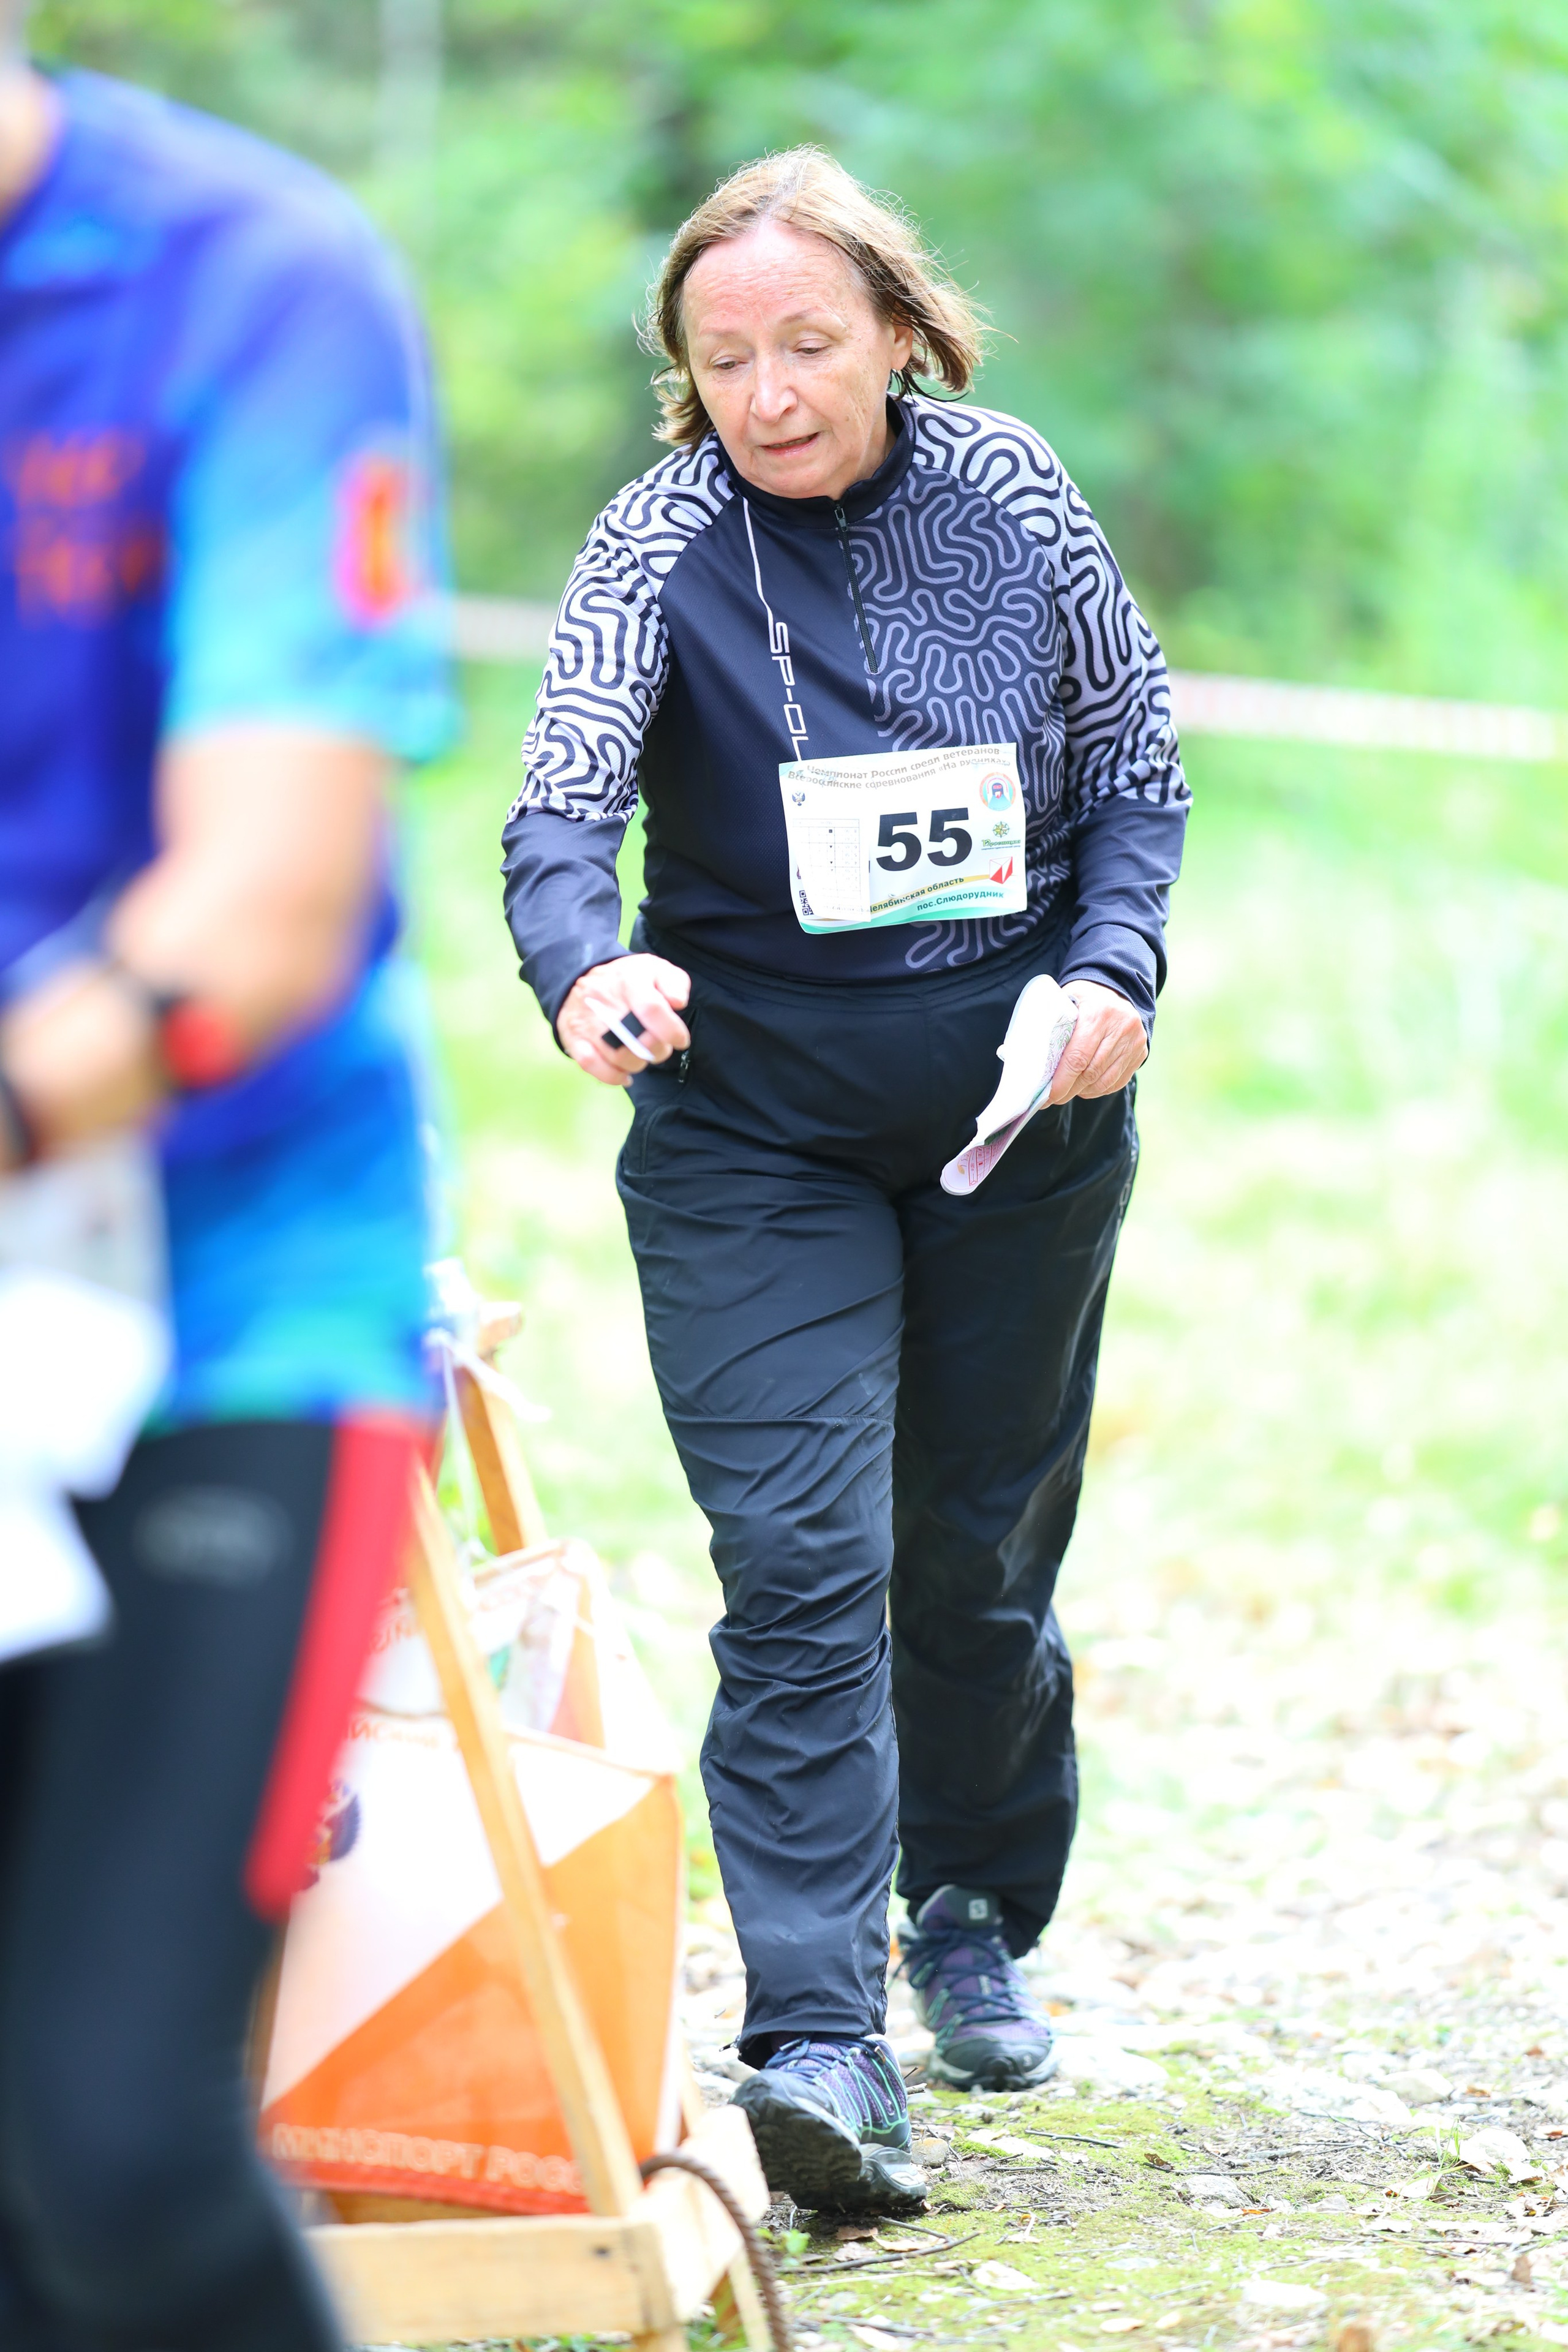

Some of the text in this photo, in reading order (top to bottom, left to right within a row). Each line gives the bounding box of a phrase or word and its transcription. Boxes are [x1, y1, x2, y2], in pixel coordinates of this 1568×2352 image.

[807, 748, 1000, 779] Чемпионат России среди ветеранов
[865, 768, 937, 789] соревнования
[869, 807, 973, 872] 55
[927, 876, 965, 893] область
[916, 891, 1005, 911] пос.Слюдорудник
